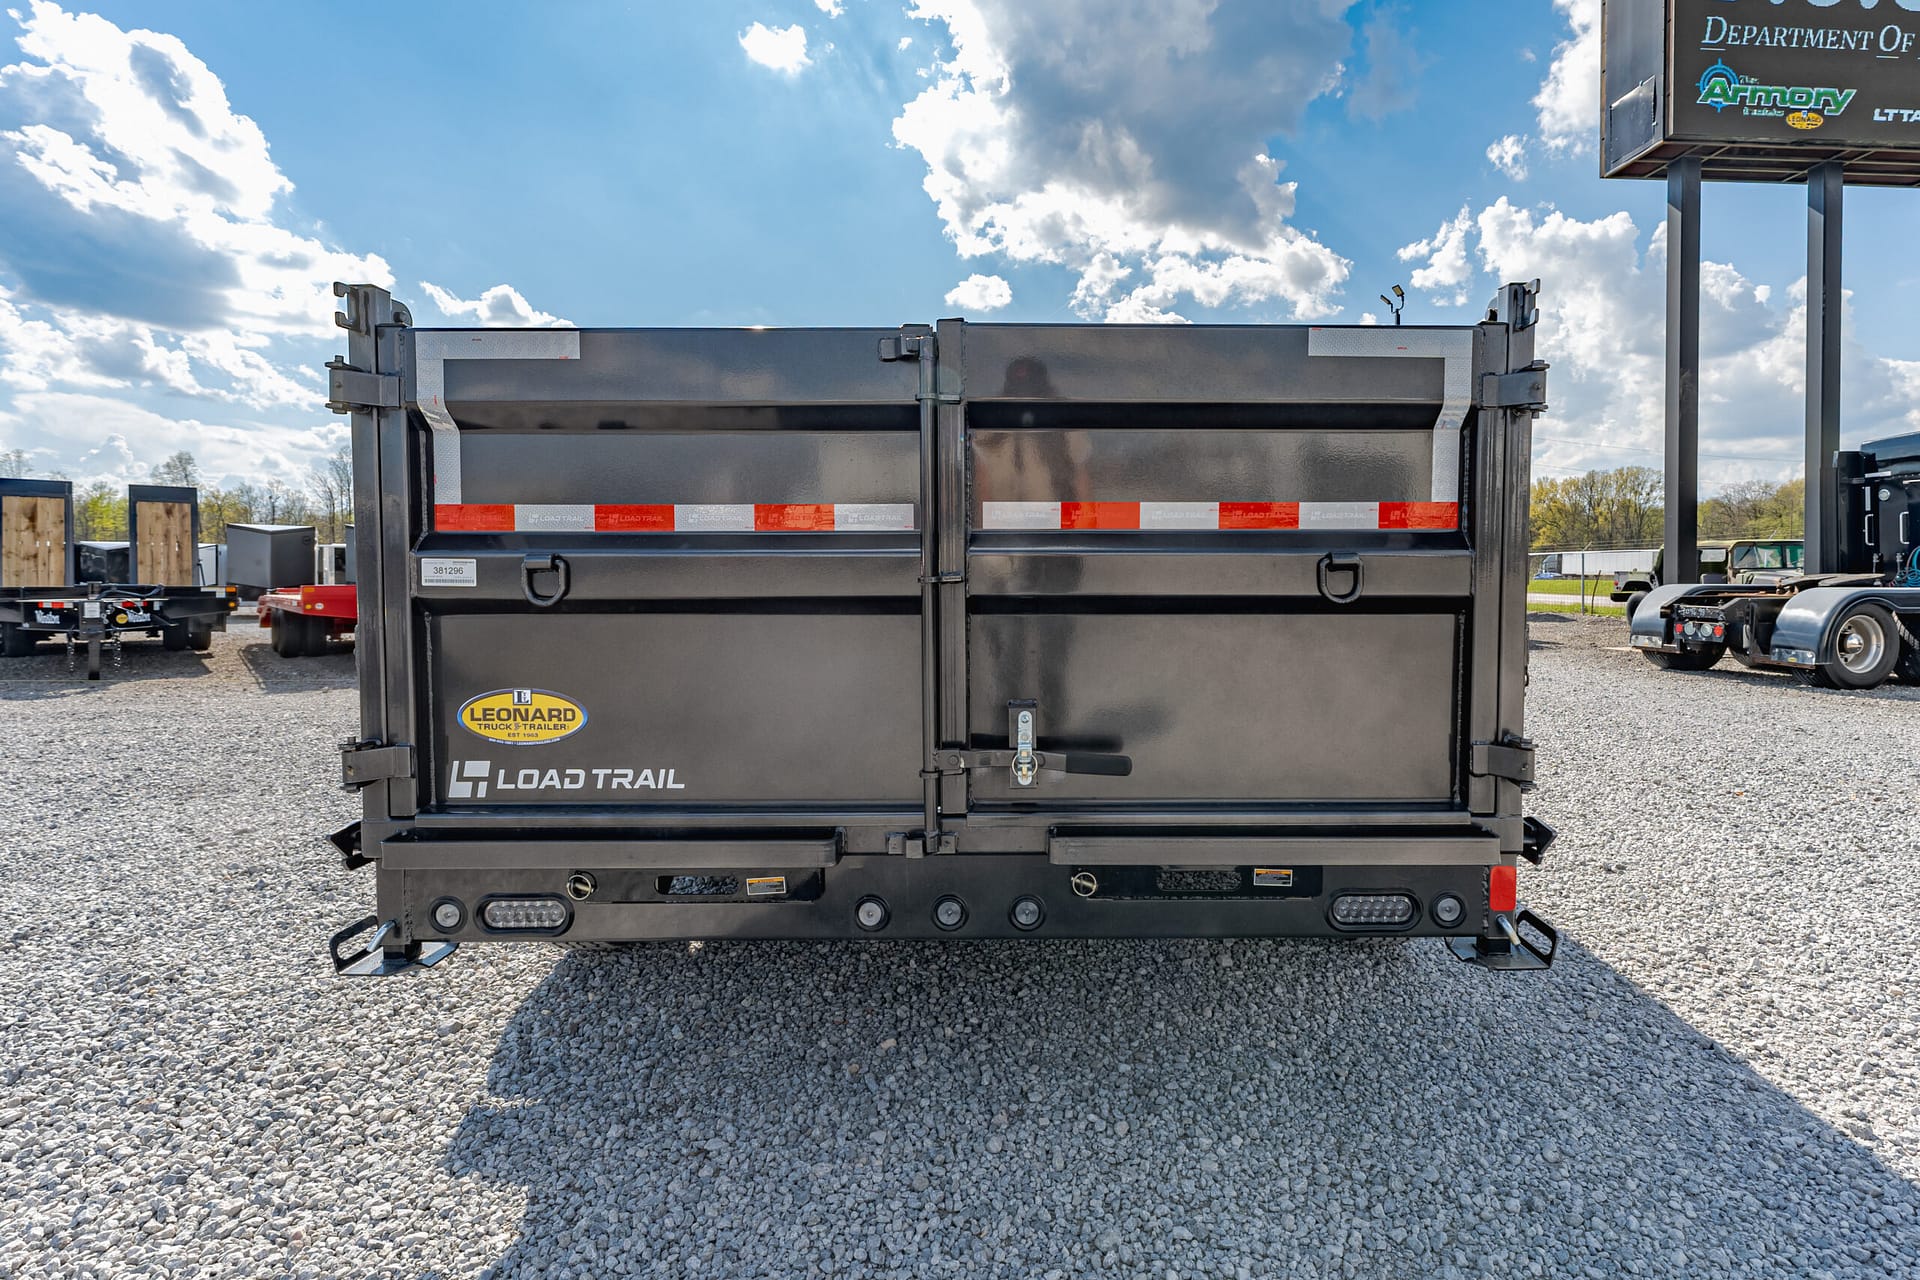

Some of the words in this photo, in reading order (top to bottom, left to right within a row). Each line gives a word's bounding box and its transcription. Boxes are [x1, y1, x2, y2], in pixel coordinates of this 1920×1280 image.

[1696, 77, 1857, 115] Armory
[540, 514, 561, 522] LOAD
[562, 514, 585, 522] TRAIL
[433, 566, 464, 574] 381296
[470, 707, 576, 722] LEONARD
[477, 723, 512, 731] TRUCK
[521, 723, 567, 731] TRAILER
[496, 768, 586, 790] LOAD
[591, 768, 685, 790] TRAIL
